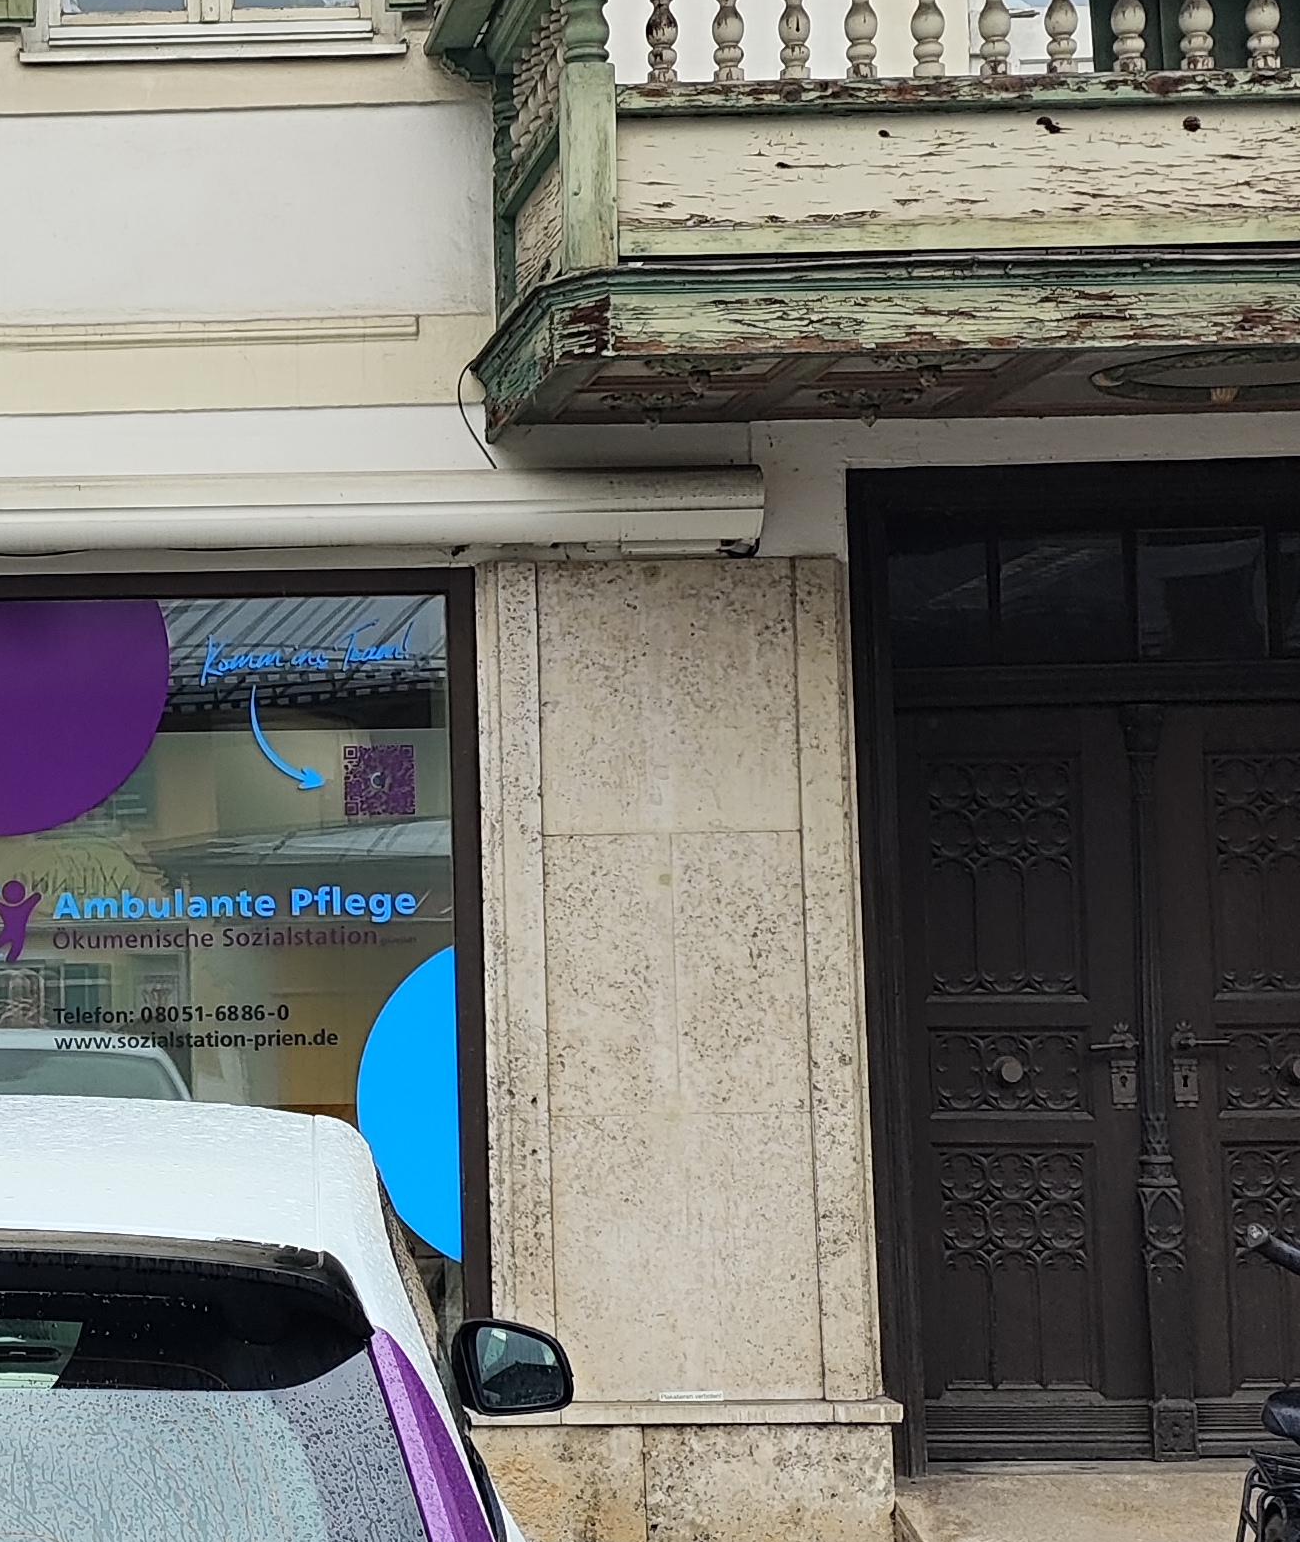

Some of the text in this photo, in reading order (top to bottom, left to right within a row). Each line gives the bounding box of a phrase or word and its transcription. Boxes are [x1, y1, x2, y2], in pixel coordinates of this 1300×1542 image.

[52, 884, 417, 923] Ambulante Pflege
[52, 927, 214, 950] Ökumenische
[222, 925, 378, 947] Sozialstation
[53, 1004, 290, 1025] Telefon: 08051-6886-0
[54, 1028, 339, 1051] www.sozialstation-prien.de
